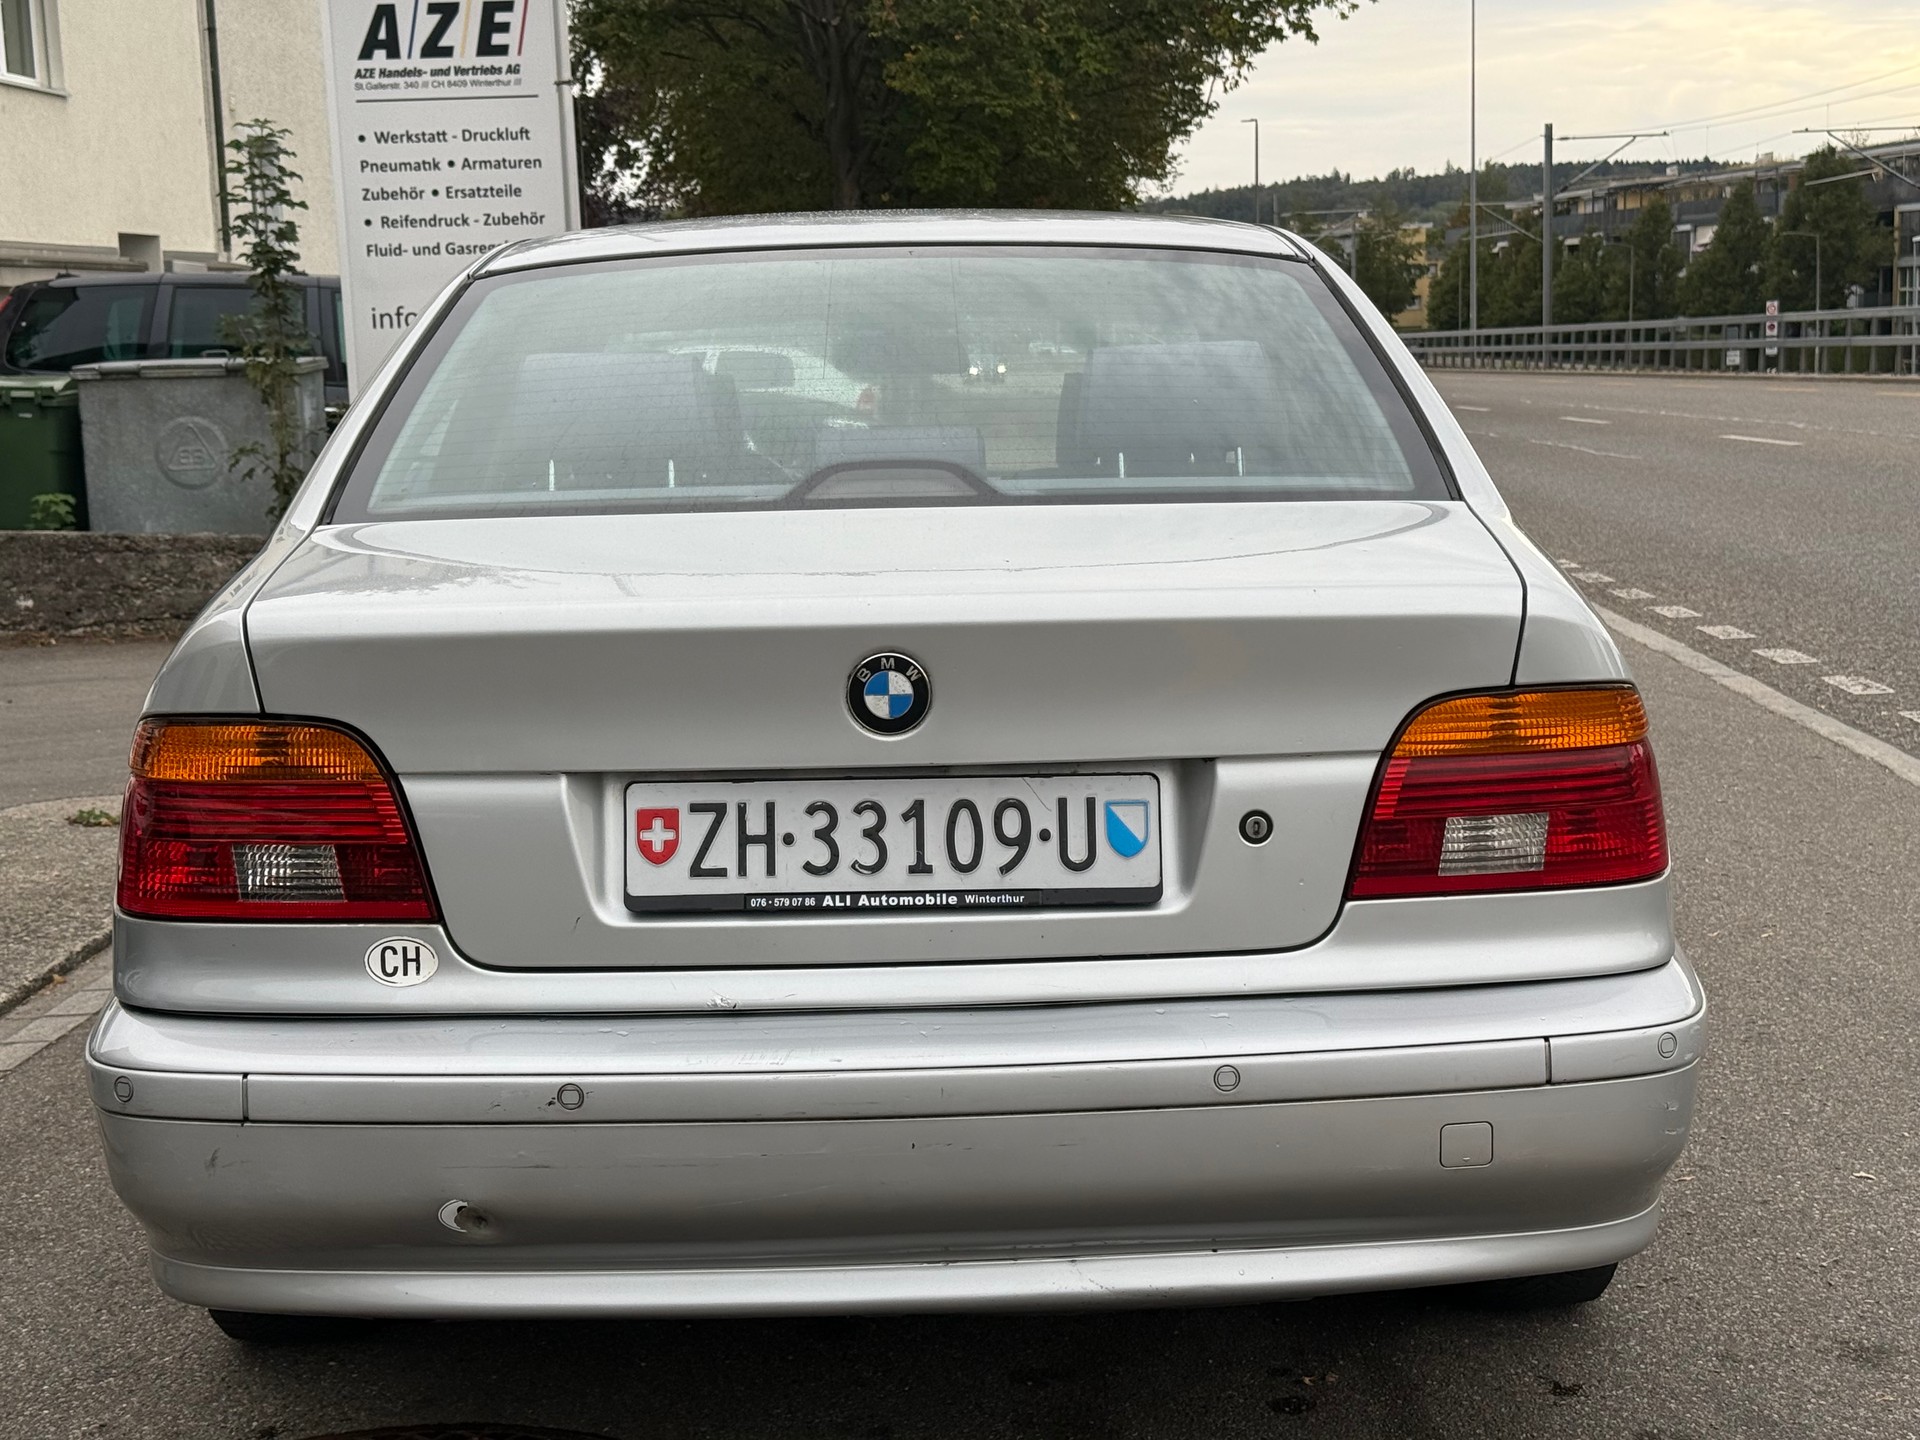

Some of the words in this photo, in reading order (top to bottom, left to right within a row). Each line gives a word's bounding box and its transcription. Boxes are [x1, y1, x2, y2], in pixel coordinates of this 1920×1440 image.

[354, 67, 376, 79] AZE
[378, 67, 428, 78] Handels-
[430, 66, 451, 77] und
[453, 65, 503, 76] Vertriebs
[505, 64, 521, 75] AG
[431, 80, 446, 88] CH
[446, 79, 468, 88] 8409
[469, 78, 512, 87] Winterthur
[373, 130, 448, 144] Werkstatt
[461, 126, 531, 142] Druckluft
[360, 157, 441, 173] Pneumatik
[461, 157, 542, 170] Armaturen
[362, 186, 425, 201] Zubehör
[445, 183, 522, 199] Ersatzteile
[380, 213, 470, 229] Reifendruck
[483, 211, 546, 227] Zubehör
[366, 243, 408, 257] Fluid-
[412, 242, 441, 256] und
[856, 657, 922, 683] BMW
[750, 898, 767, 907] 076
[773, 897, 790, 907] 579
[791, 897, 803, 906] 07
[804, 897, 816, 906] 86
[822, 895, 851, 907] ALI
[858, 893, 958, 906] Automobile
[964, 894, 1025, 904] Winterthur
[380, 945, 421, 978] CH
